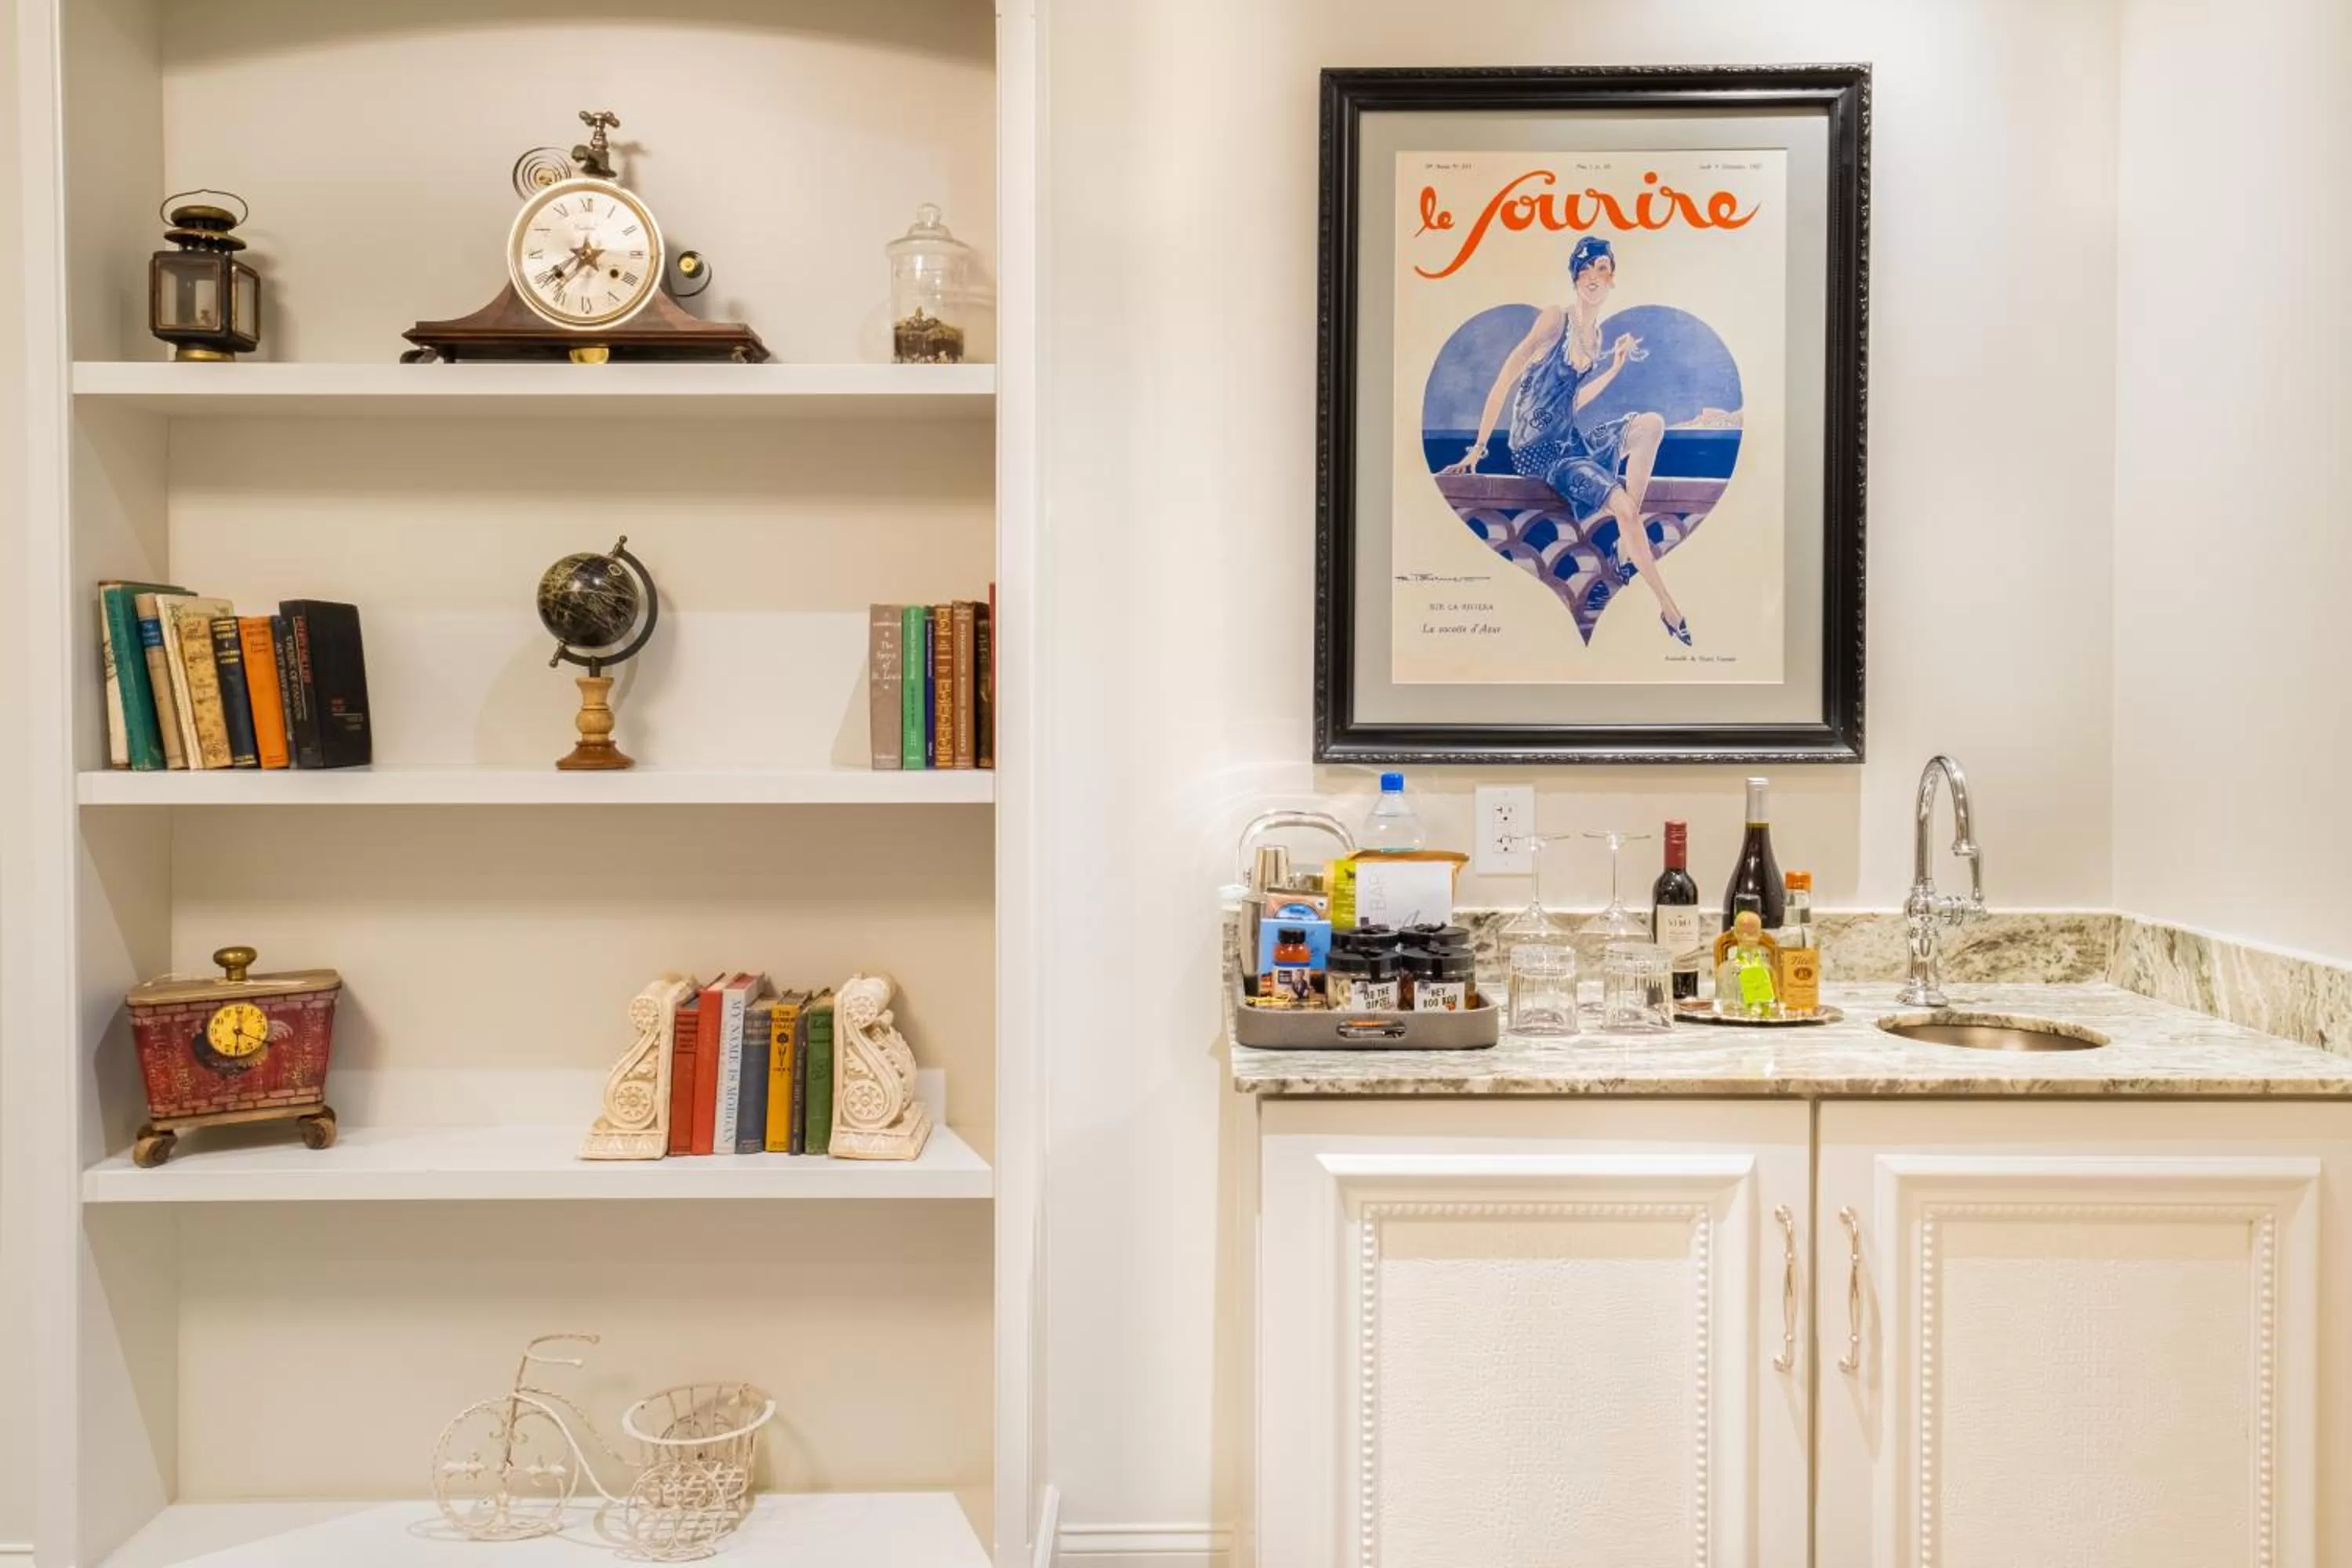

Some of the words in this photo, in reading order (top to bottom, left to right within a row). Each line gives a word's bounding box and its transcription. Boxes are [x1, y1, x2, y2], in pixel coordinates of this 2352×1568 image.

[1414, 185, 1456, 238] le
[1414, 169, 1762, 280] Sourire
[728, 1024, 742, 1064] NAME
[722, 1083, 739, 1143] MORGAN
